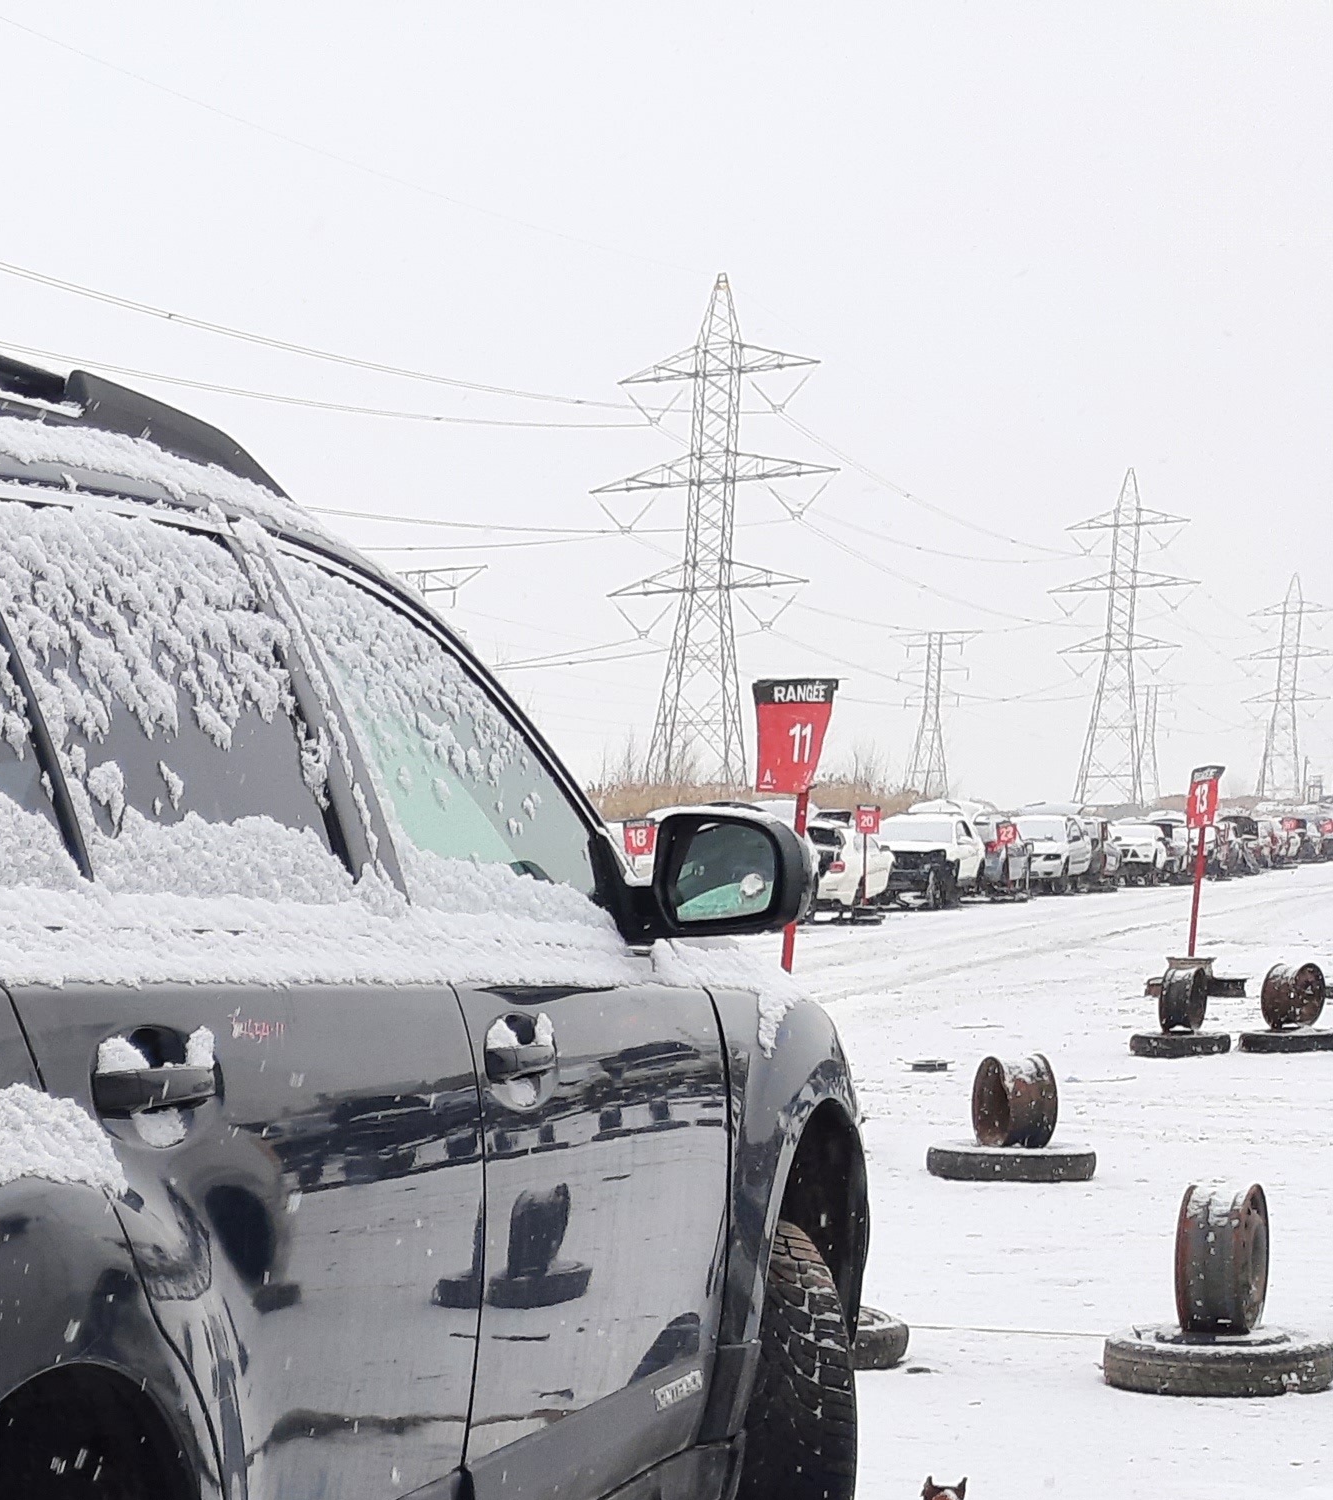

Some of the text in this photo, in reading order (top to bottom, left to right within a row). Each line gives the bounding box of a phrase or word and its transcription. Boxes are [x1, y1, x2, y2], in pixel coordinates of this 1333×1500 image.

[788, 722, 812, 764] 11
[1194, 783, 1209, 815] 13
[860, 814, 874, 828] 20
[628, 828, 648, 848] 18
[1000, 826, 1014, 842] 22
